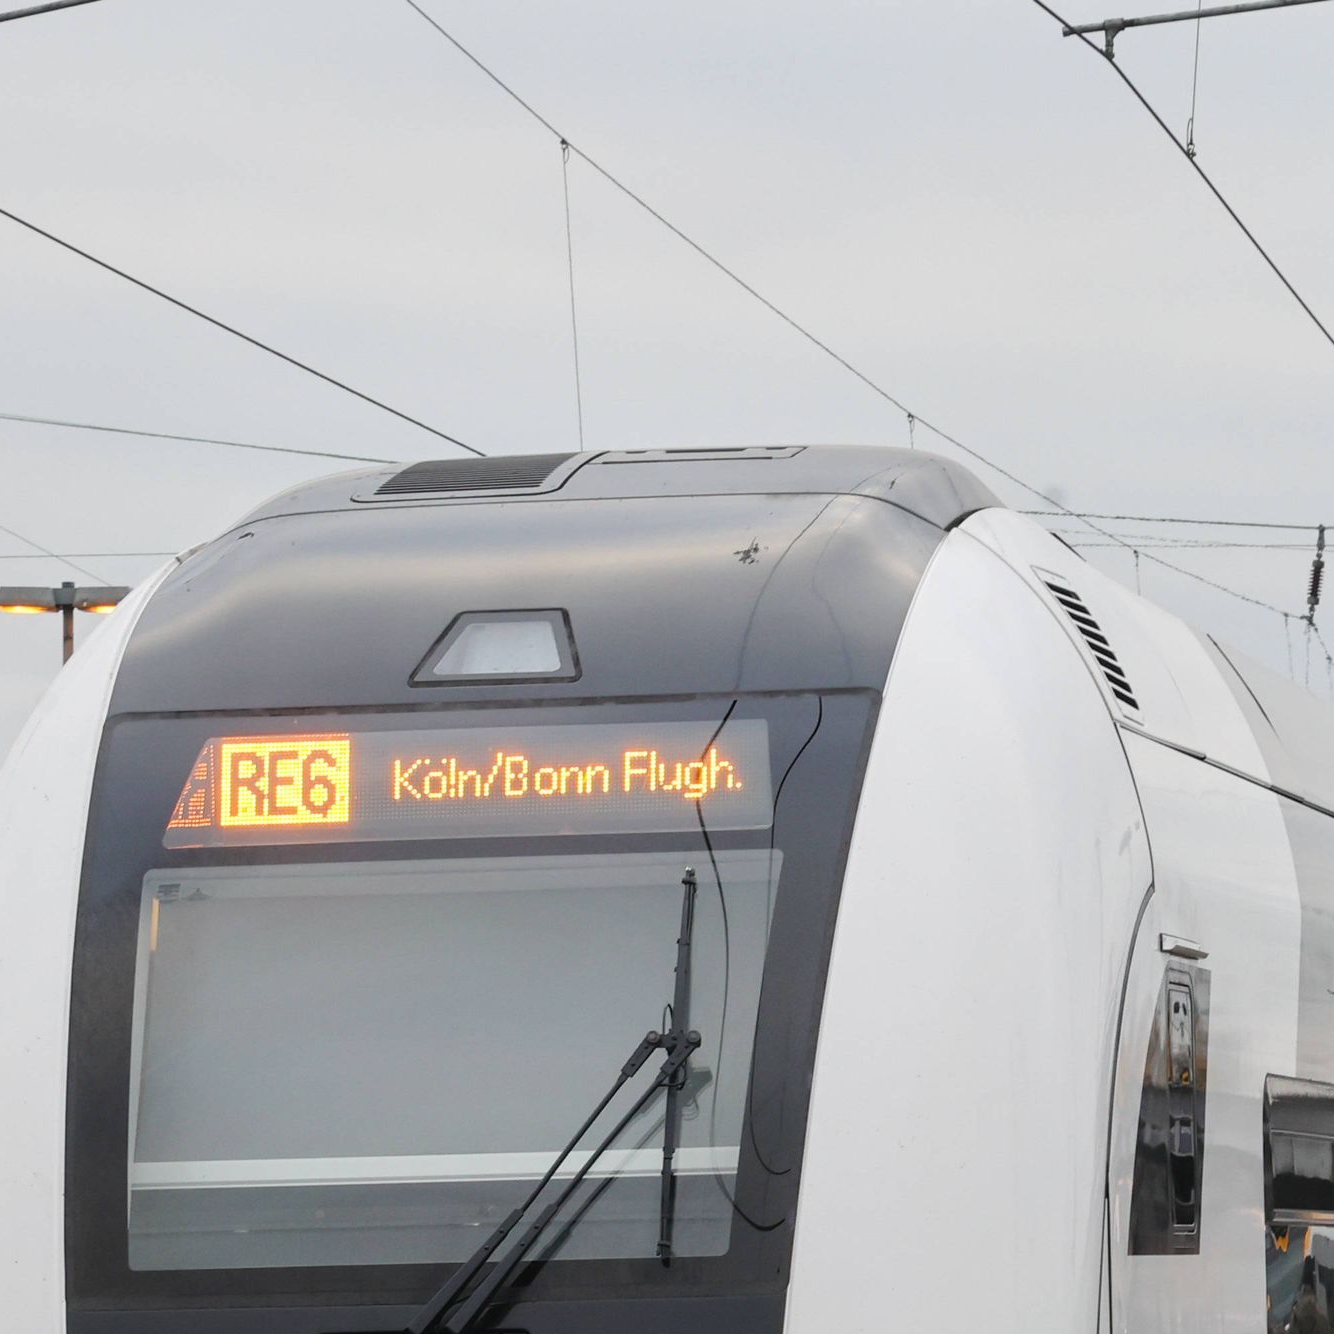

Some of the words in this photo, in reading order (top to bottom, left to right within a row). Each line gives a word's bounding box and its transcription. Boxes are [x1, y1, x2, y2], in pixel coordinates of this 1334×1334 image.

[229, 750, 338, 819] RE6
[393, 752, 610, 801] Köln/Bonn
[623, 748, 743, 799] Flugh.
